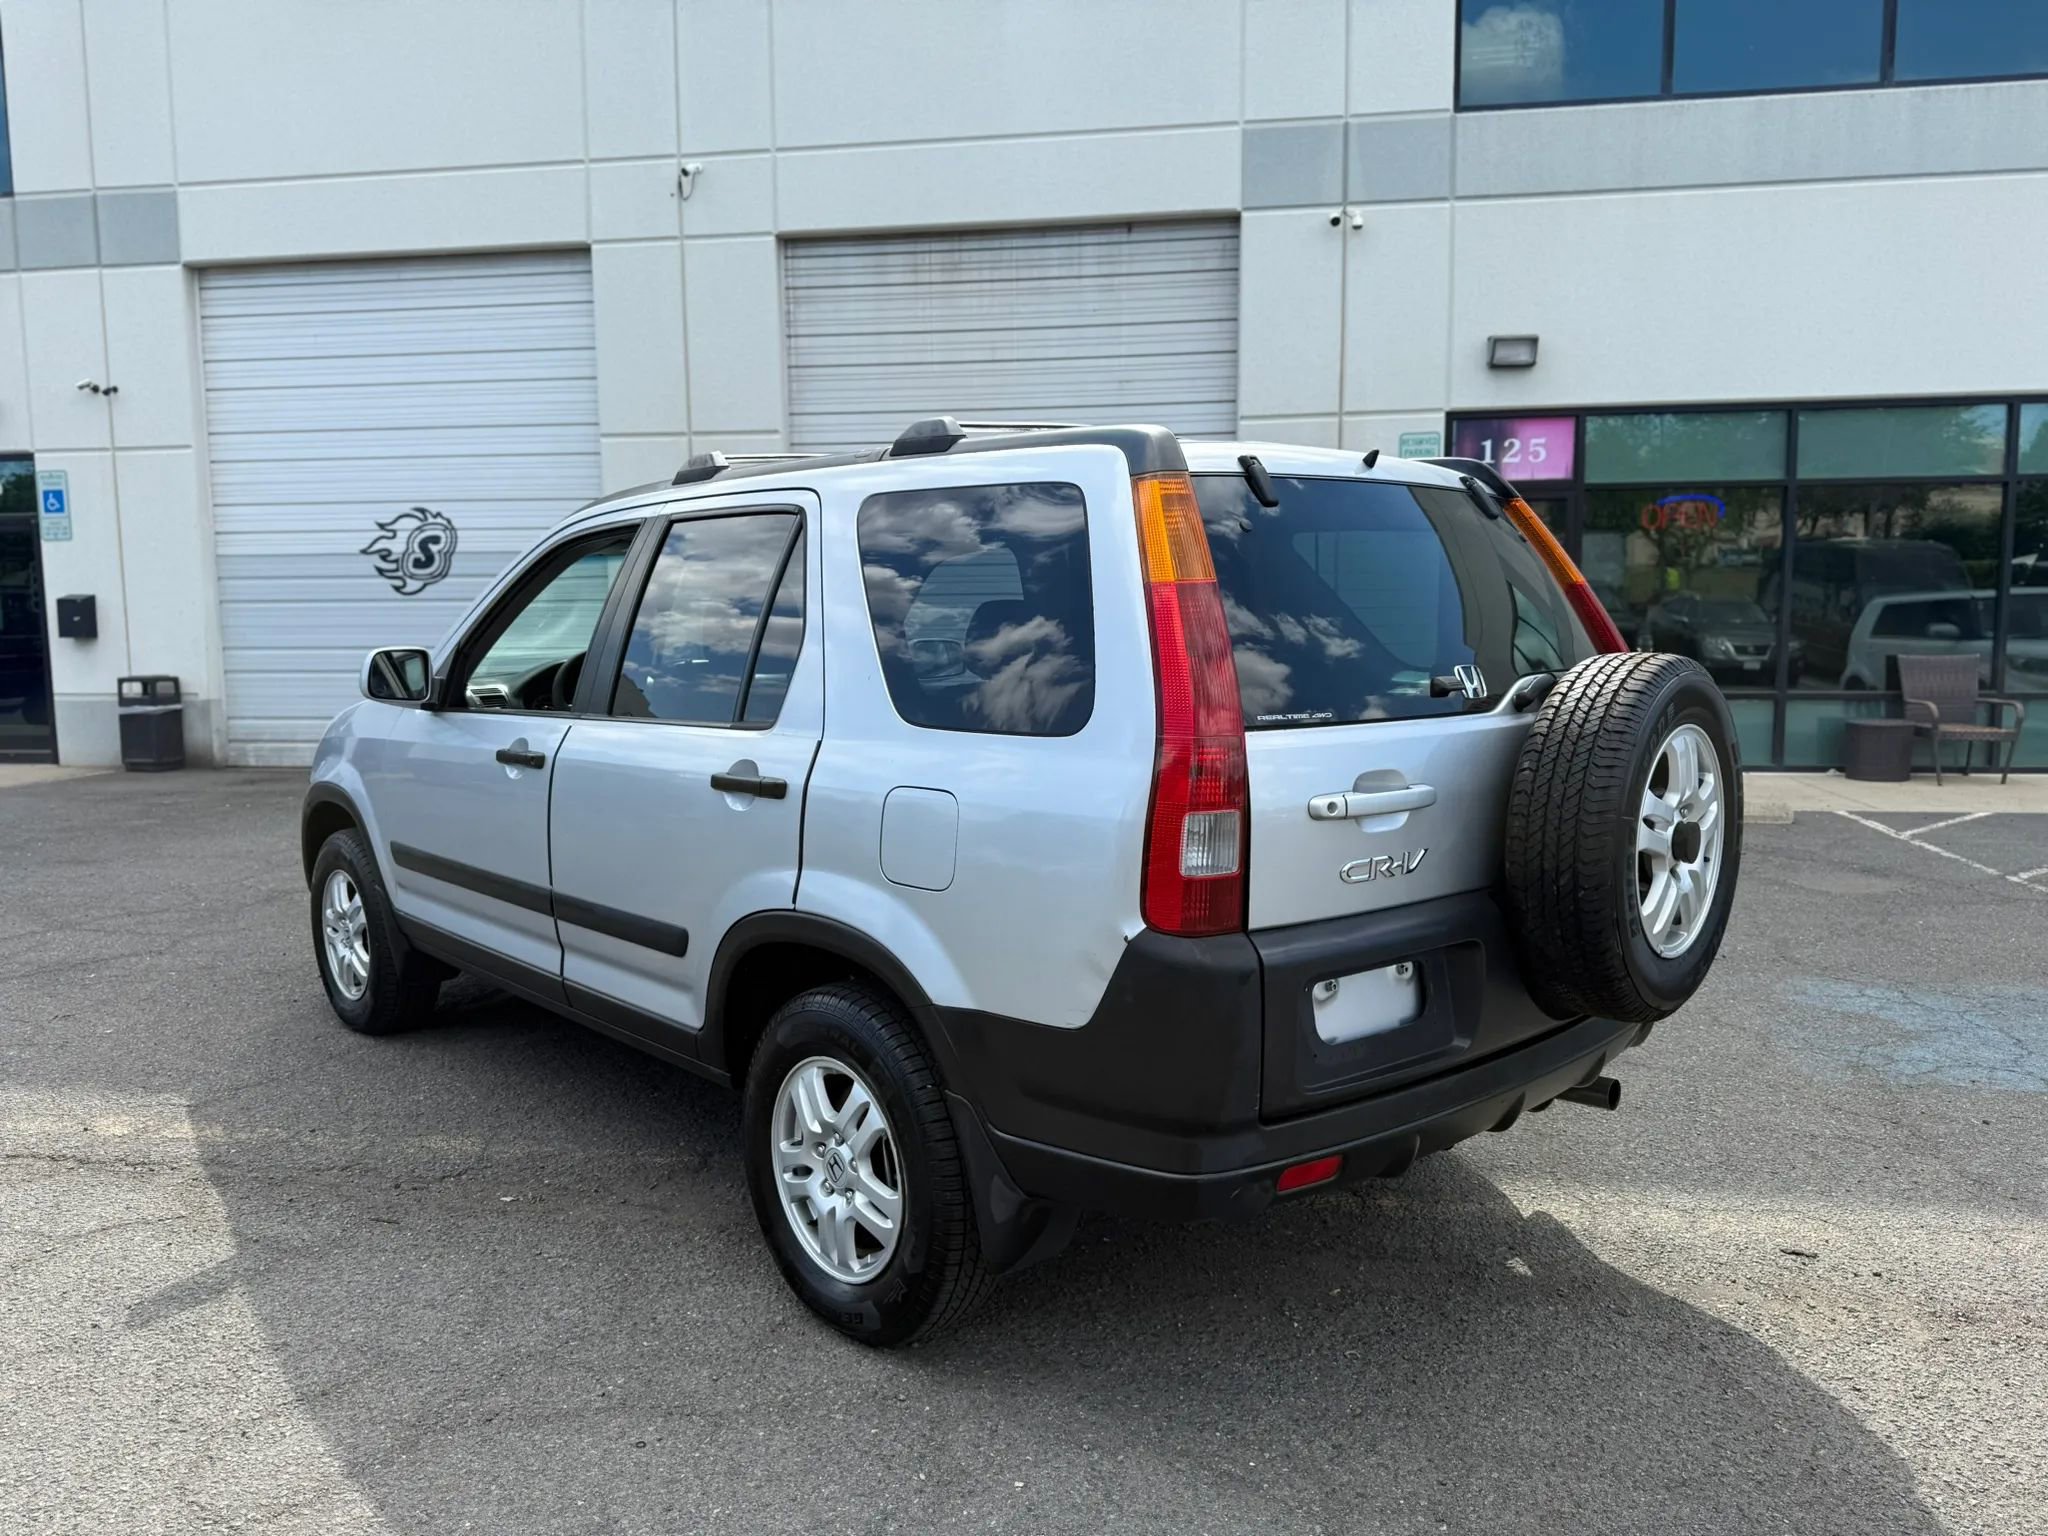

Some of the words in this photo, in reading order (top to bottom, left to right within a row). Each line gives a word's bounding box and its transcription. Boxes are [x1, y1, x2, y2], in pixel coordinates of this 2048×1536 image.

[1480, 438, 1548, 464] 125
[1642, 501, 1718, 529] OPEN
[412, 534, 442, 570] S
[1339, 848, 1429, 884] CR-V
